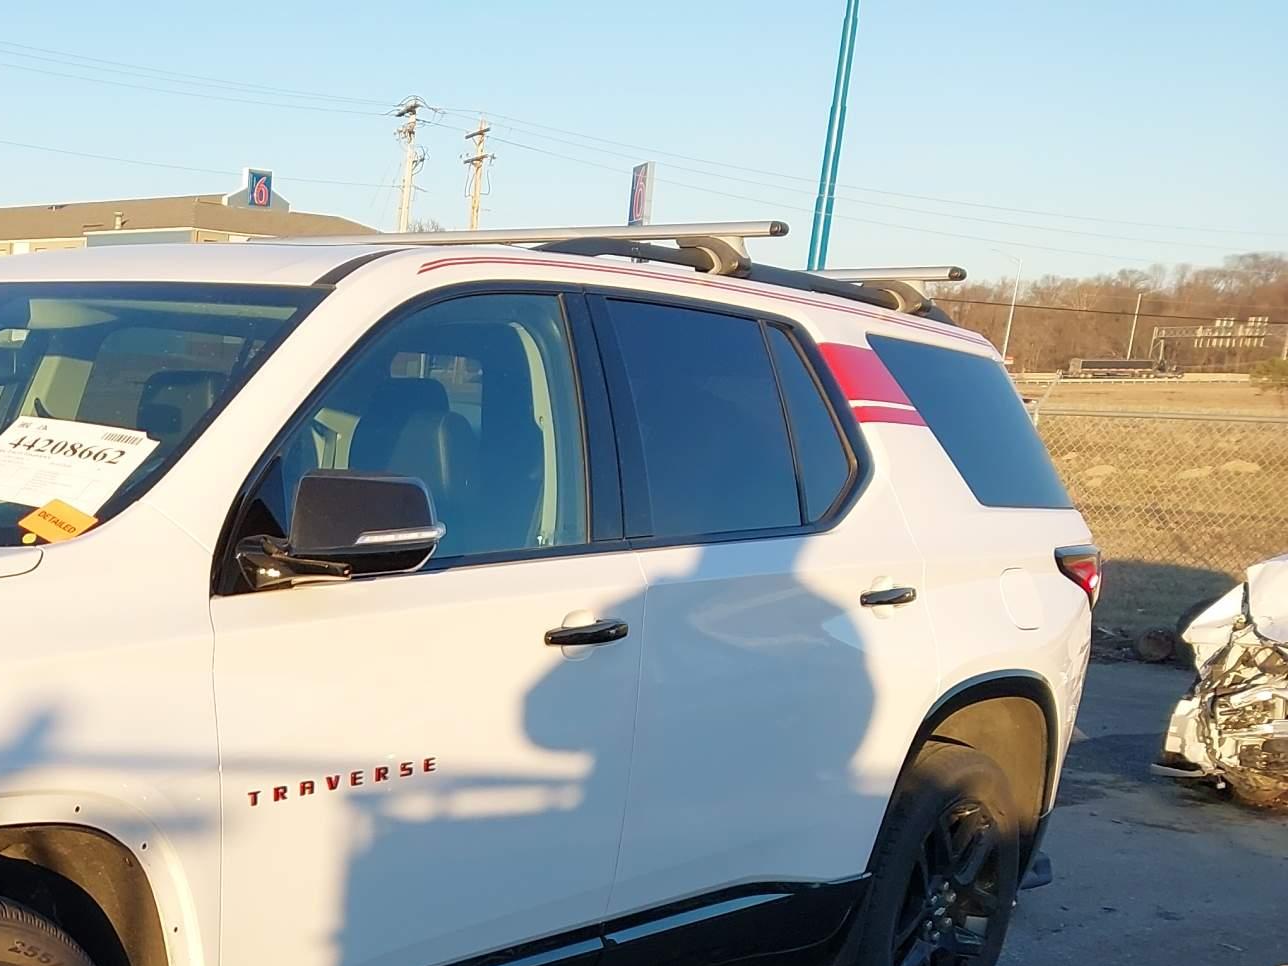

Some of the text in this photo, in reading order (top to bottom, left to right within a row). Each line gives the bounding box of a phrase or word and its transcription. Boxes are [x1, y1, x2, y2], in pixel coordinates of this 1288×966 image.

[254, 176, 269, 206] 6
[8, 435, 127, 465] 44208662
[37, 510, 77, 535] DETAILED
[247, 756, 437, 807] TRAVERSE
